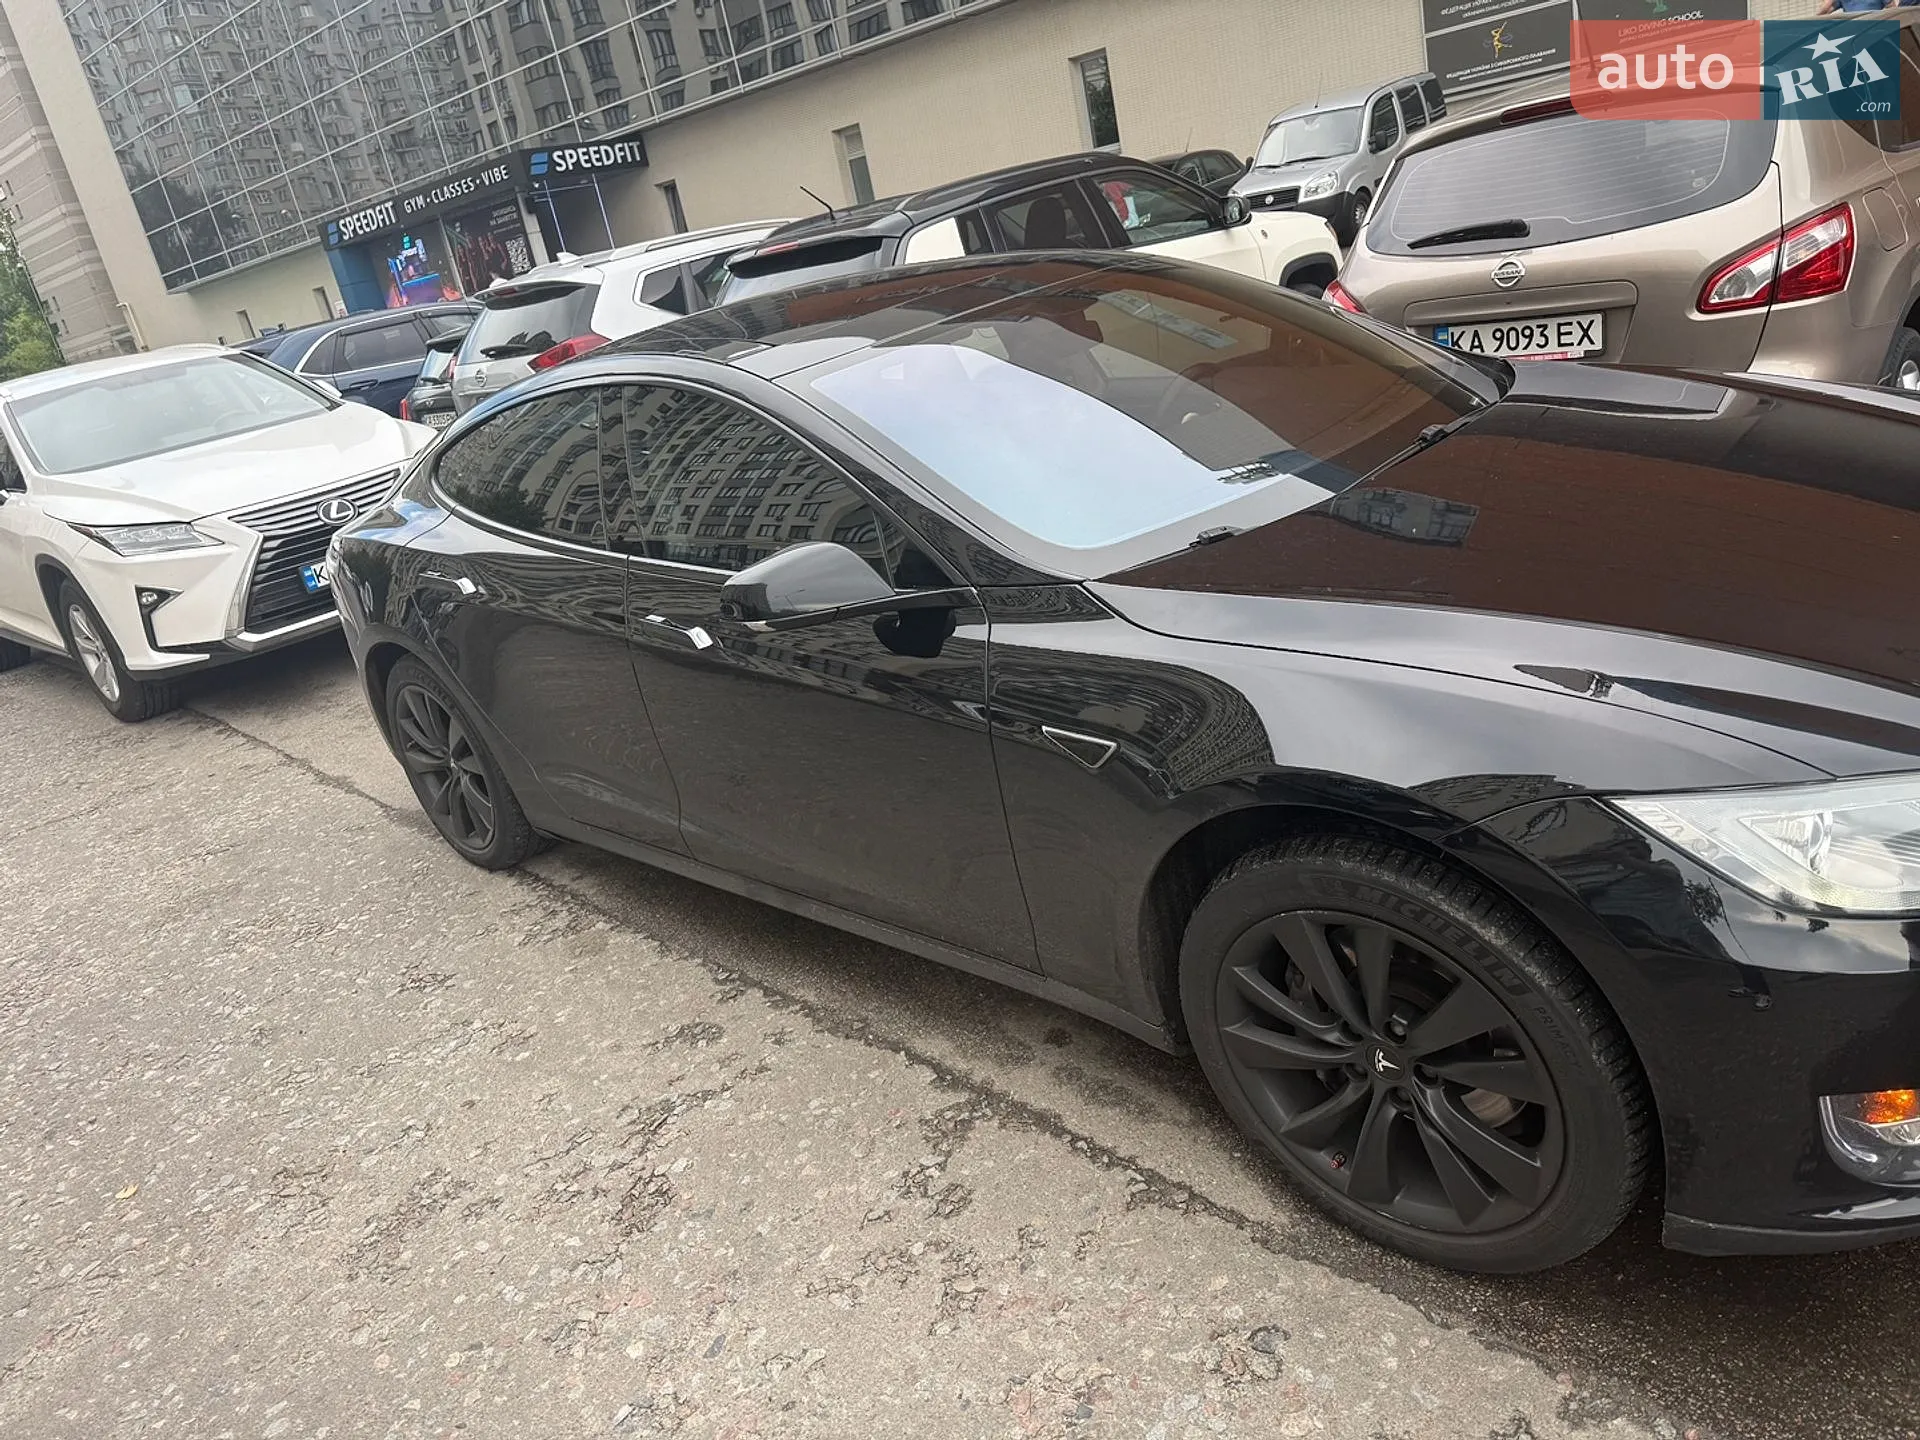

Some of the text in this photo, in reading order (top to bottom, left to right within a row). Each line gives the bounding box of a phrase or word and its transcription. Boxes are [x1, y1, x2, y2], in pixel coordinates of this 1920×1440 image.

[1638, 19, 1667, 33] DIVING
[1668, 10, 1704, 26] SCHOOL
[552, 141, 642, 173] SPEEDFIT
[338, 164, 509, 241] SPEEDFIT GYM CLASSES VIBE
[1450, 319, 1595, 354] KA 9093 EX
[1353, 886, 1533, 996] MICHELIN
[1533, 1005, 1582, 1068] PRIMACY
